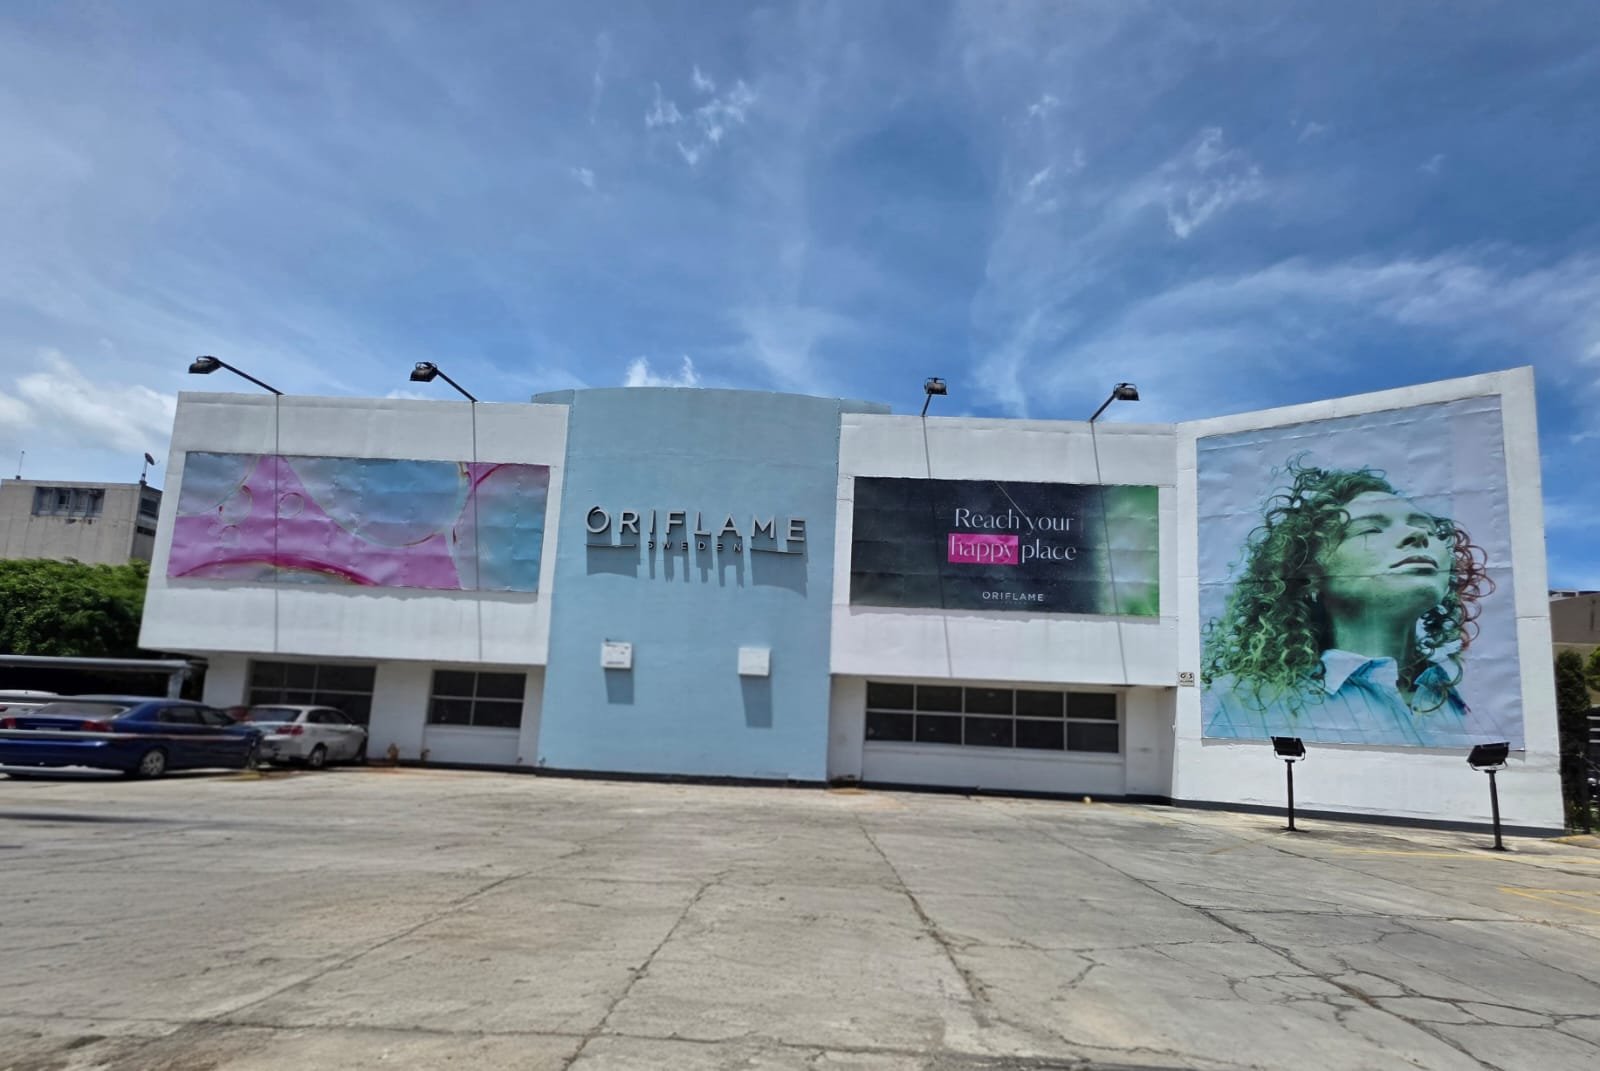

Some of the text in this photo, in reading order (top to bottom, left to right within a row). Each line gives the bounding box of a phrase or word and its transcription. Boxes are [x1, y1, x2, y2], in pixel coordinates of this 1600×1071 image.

[585, 506, 806, 542] ORIFLAME
[955, 508, 1075, 535] Reach your
[951, 535, 1077, 564] happy place
[982, 591, 1045, 602] ORIFLAME
